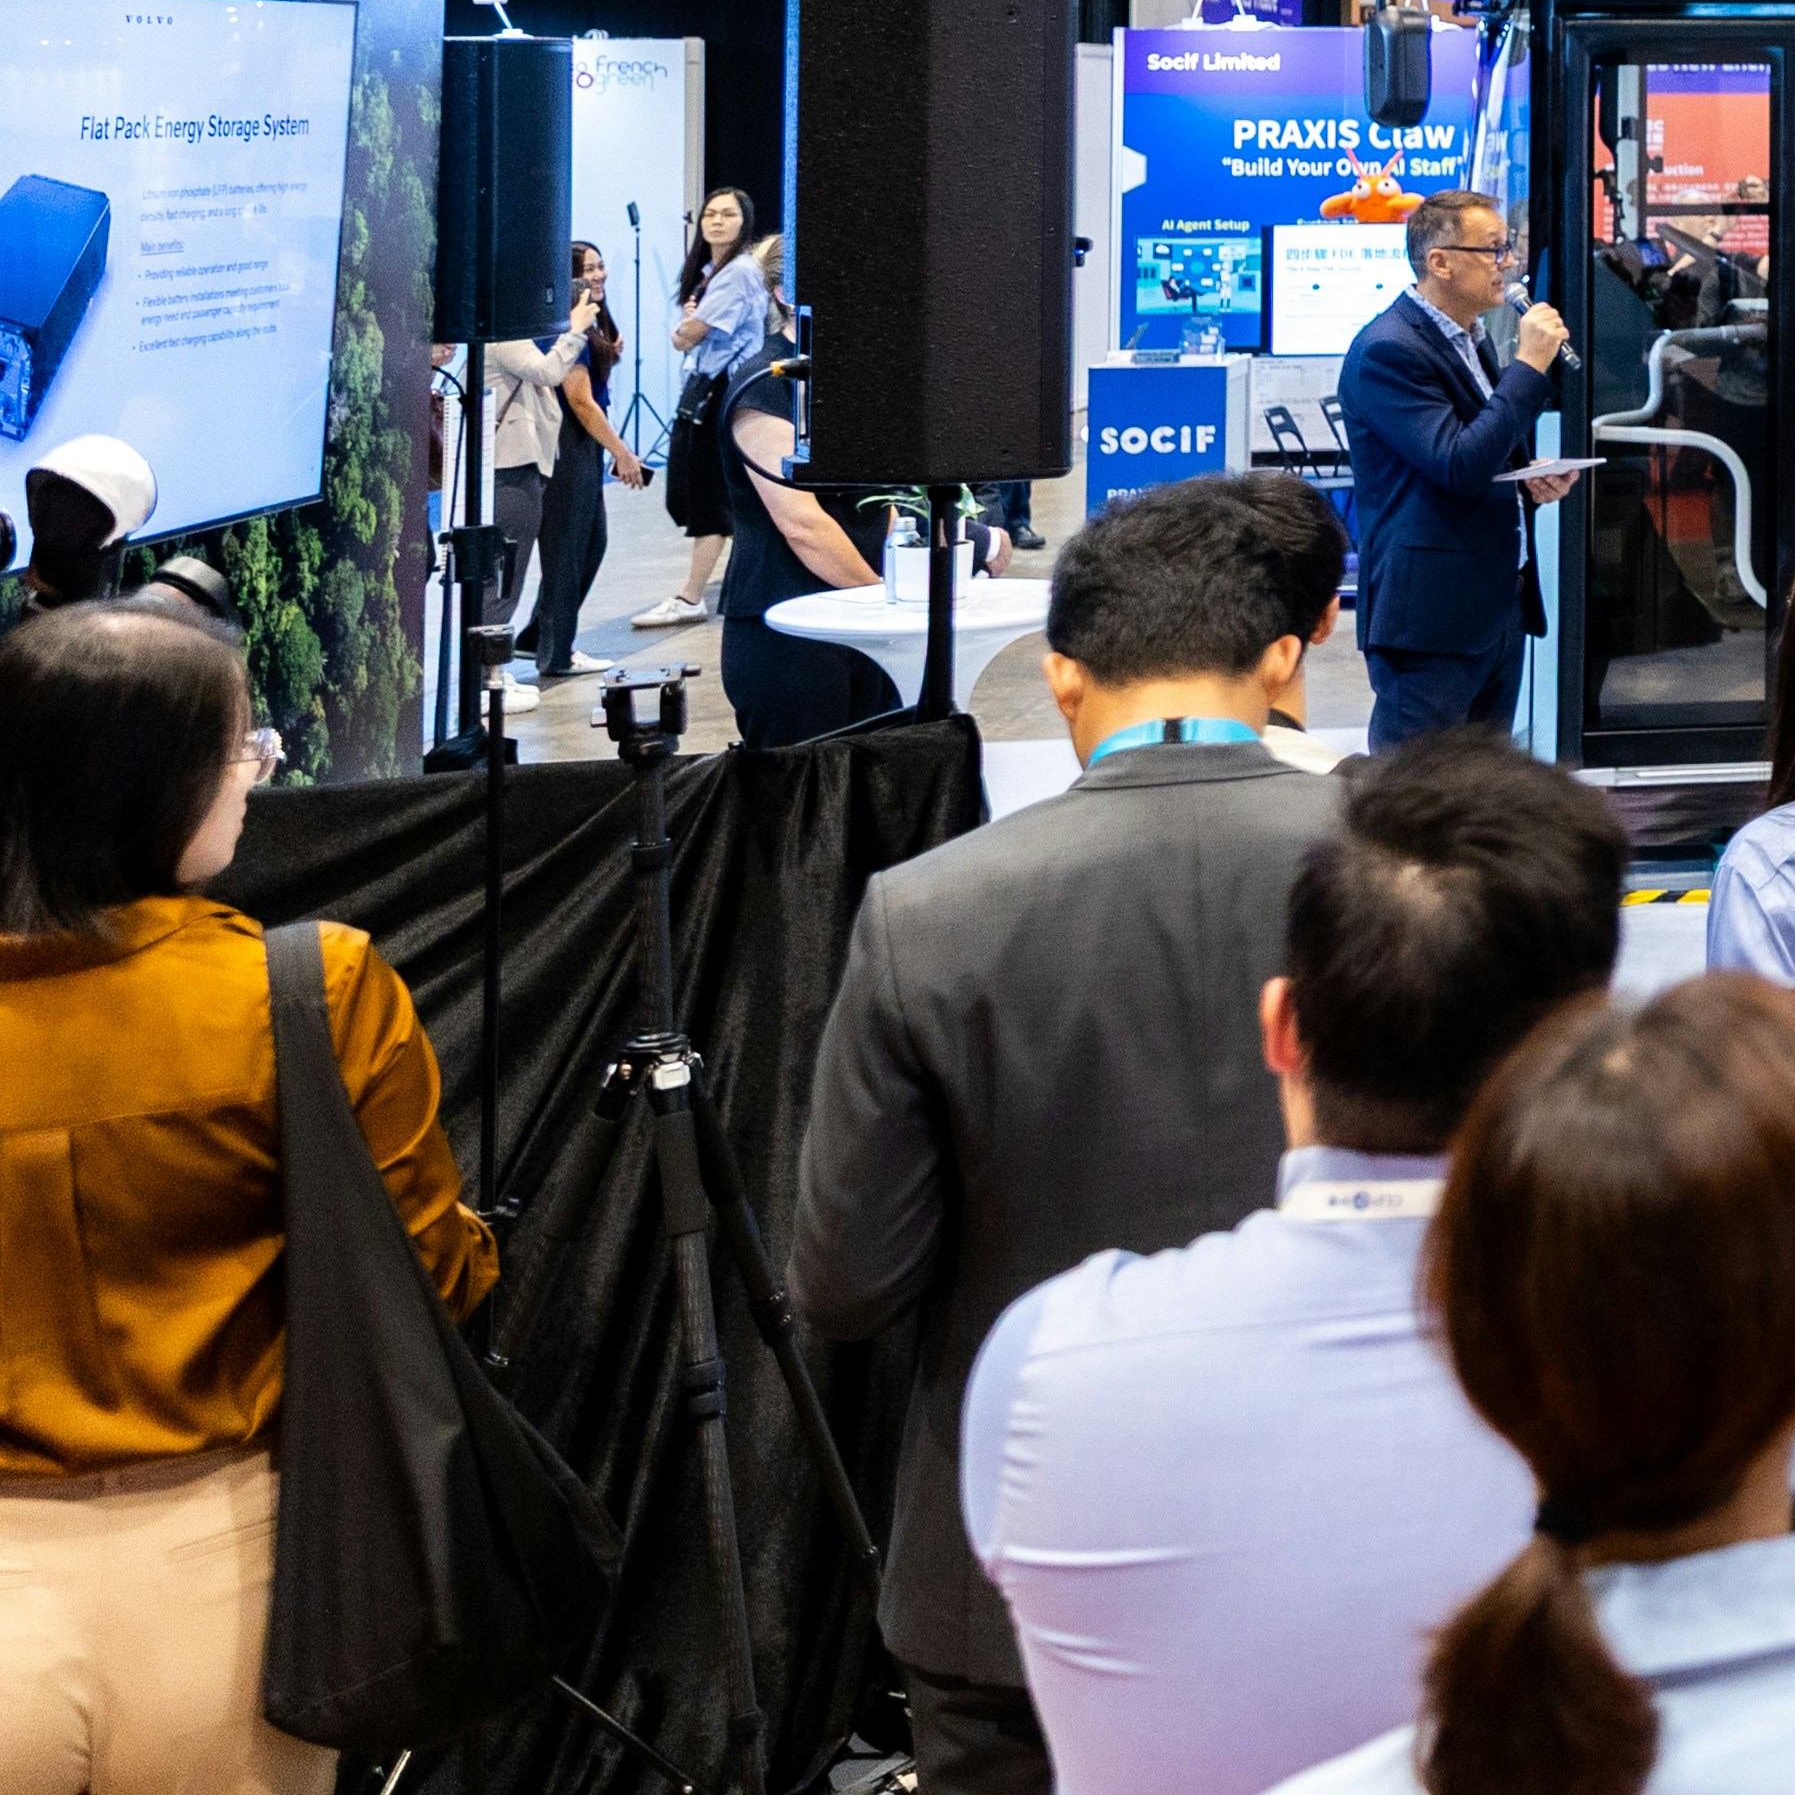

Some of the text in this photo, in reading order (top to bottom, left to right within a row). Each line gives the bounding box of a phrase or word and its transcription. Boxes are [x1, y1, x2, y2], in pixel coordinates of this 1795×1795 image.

[126, 14, 174, 25] VOLVO
[596, 54, 669, 78] french
[1147, 52, 1281, 71] Socif Limited
[81, 113, 311, 144] Flat Pack Energy Storage System
[1233, 119, 1361, 150] PRAXIS
[1368, 121, 1456, 150] Claw
[1286, 157, 1333, 177] Your
[1336, 157, 1382, 177] Own
[1162, 218, 1250, 233] AI Agent Setup
[1100, 425, 1217, 454] SOCIF
